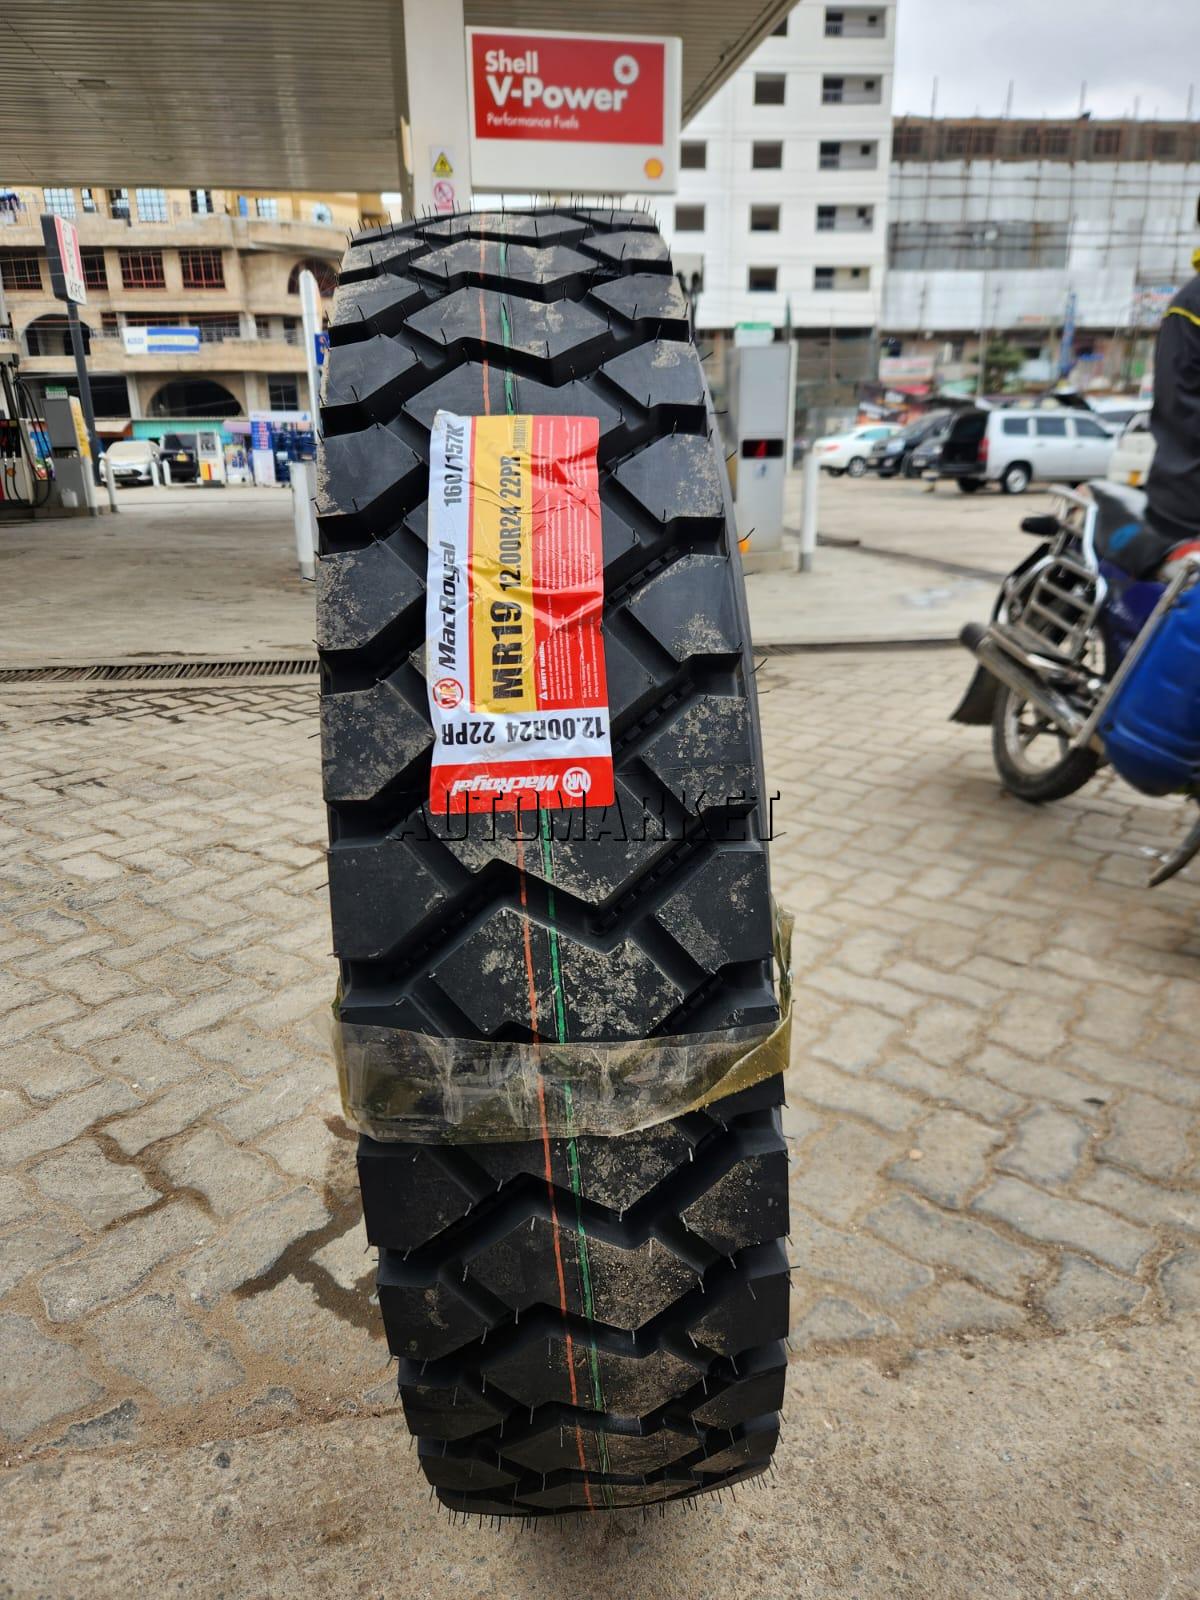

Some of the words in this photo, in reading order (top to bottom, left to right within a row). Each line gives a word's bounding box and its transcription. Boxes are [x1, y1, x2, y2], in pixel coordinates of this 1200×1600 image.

[485, 49, 538, 74] Shell
[486, 75, 628, 111] V-Power
[486, 112, 551, 129] Performance
[553, 115, 579, 130] Fuels
[443, 424, 465, 508] 160/157K
[499, 455, 522, 500] 22PR
[499, 505, 522, 592] 12.00R24
[438, 540, 460, 671] MacRoyal
[490, 600, 524, 699] MR19
[441, 720, 496, 746] 22PR
[505, 715, 606, 744] 12.00R24
[450, 774, 559, 797] MacRoyal
